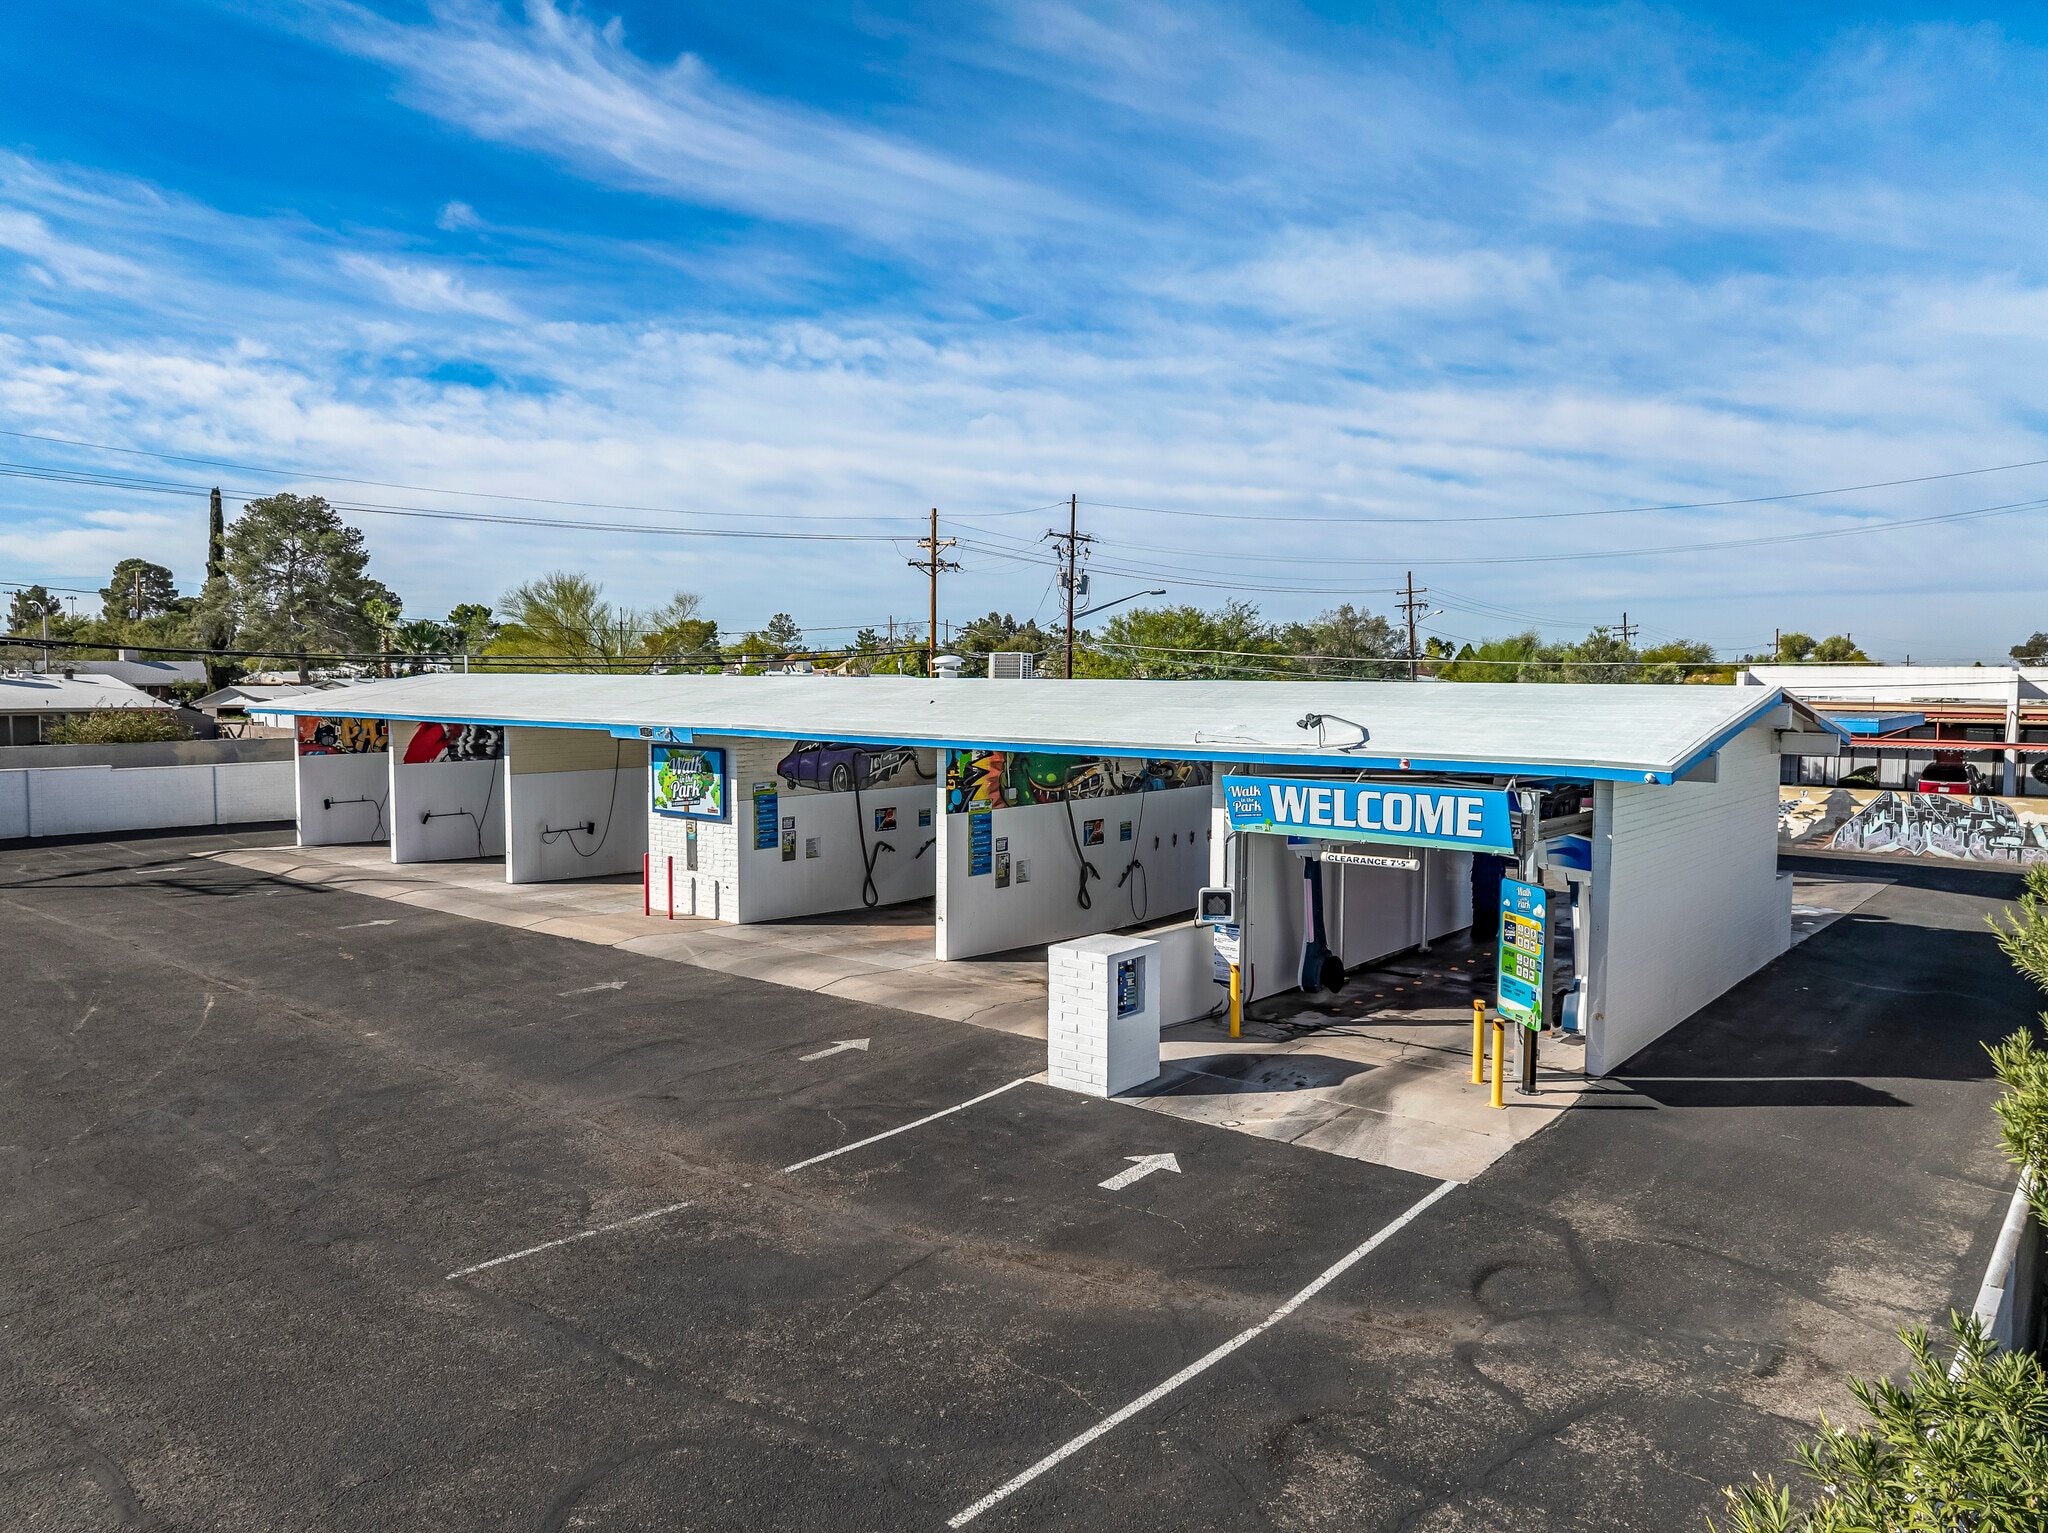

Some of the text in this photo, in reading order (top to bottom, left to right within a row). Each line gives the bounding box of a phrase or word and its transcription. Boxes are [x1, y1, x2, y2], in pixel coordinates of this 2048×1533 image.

[668, 756, 702, 775] Walk
[671, 780, 700, 799] Park
[1228, 785, 1262, 797] Walk
[1233, 801, 1262, 812] Park
[1268, 784, 1484, 838] WELCOME
[1328, 854, 1387, 866] CLEARANCE
